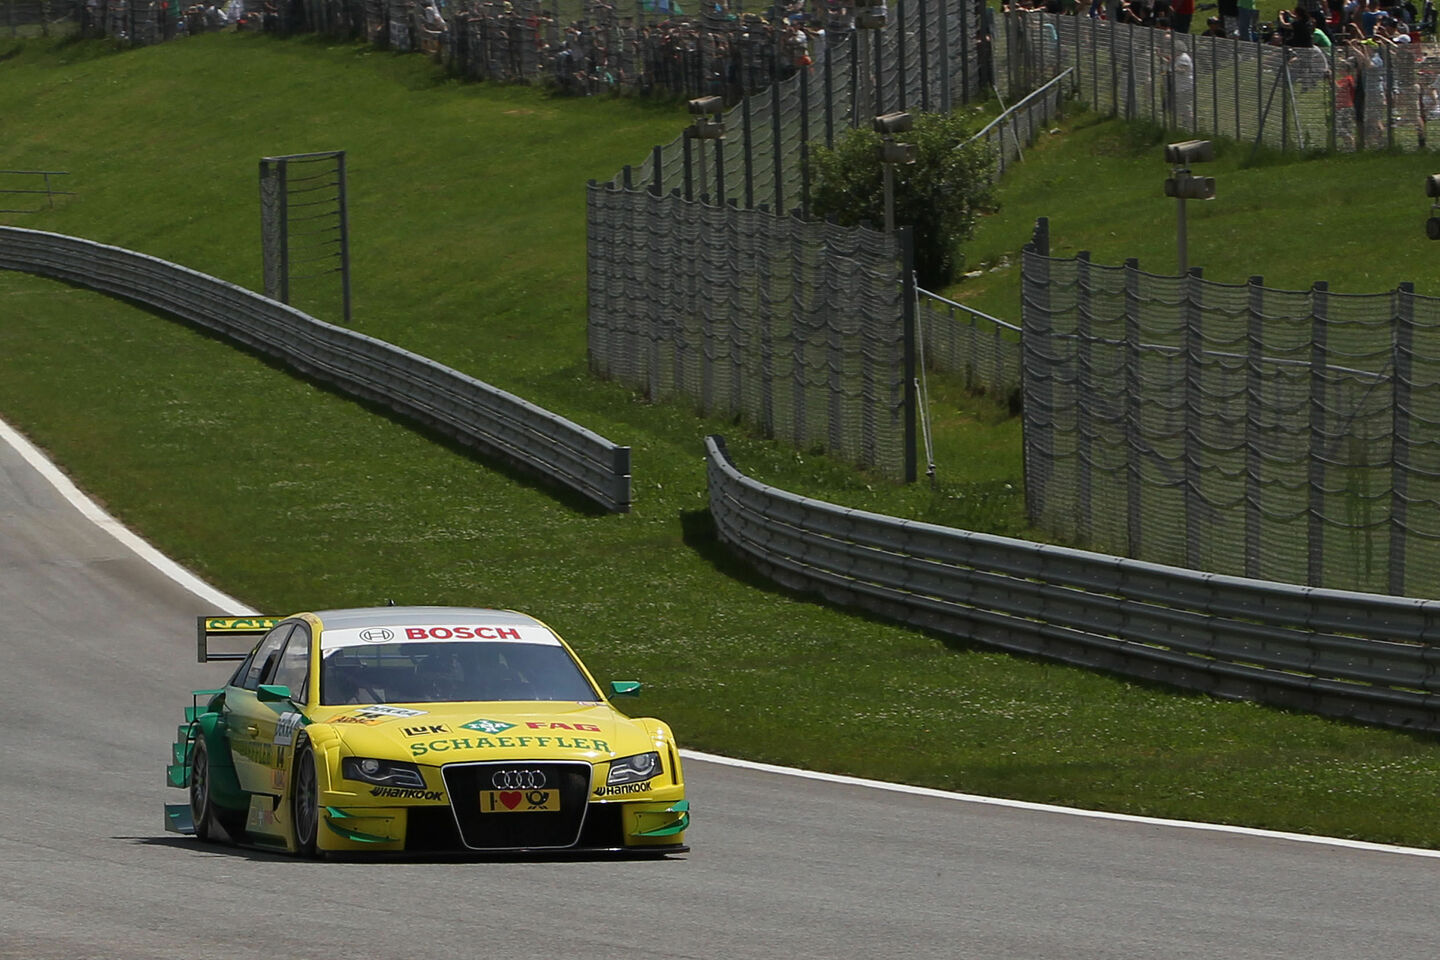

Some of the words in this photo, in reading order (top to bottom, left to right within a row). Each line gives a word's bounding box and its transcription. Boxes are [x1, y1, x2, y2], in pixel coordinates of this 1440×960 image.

[405, 627, 521, 640] BOSCH
[525, 721, 601, 732] FAG
[410, 736, 611, 757] SCHAEFFLER
